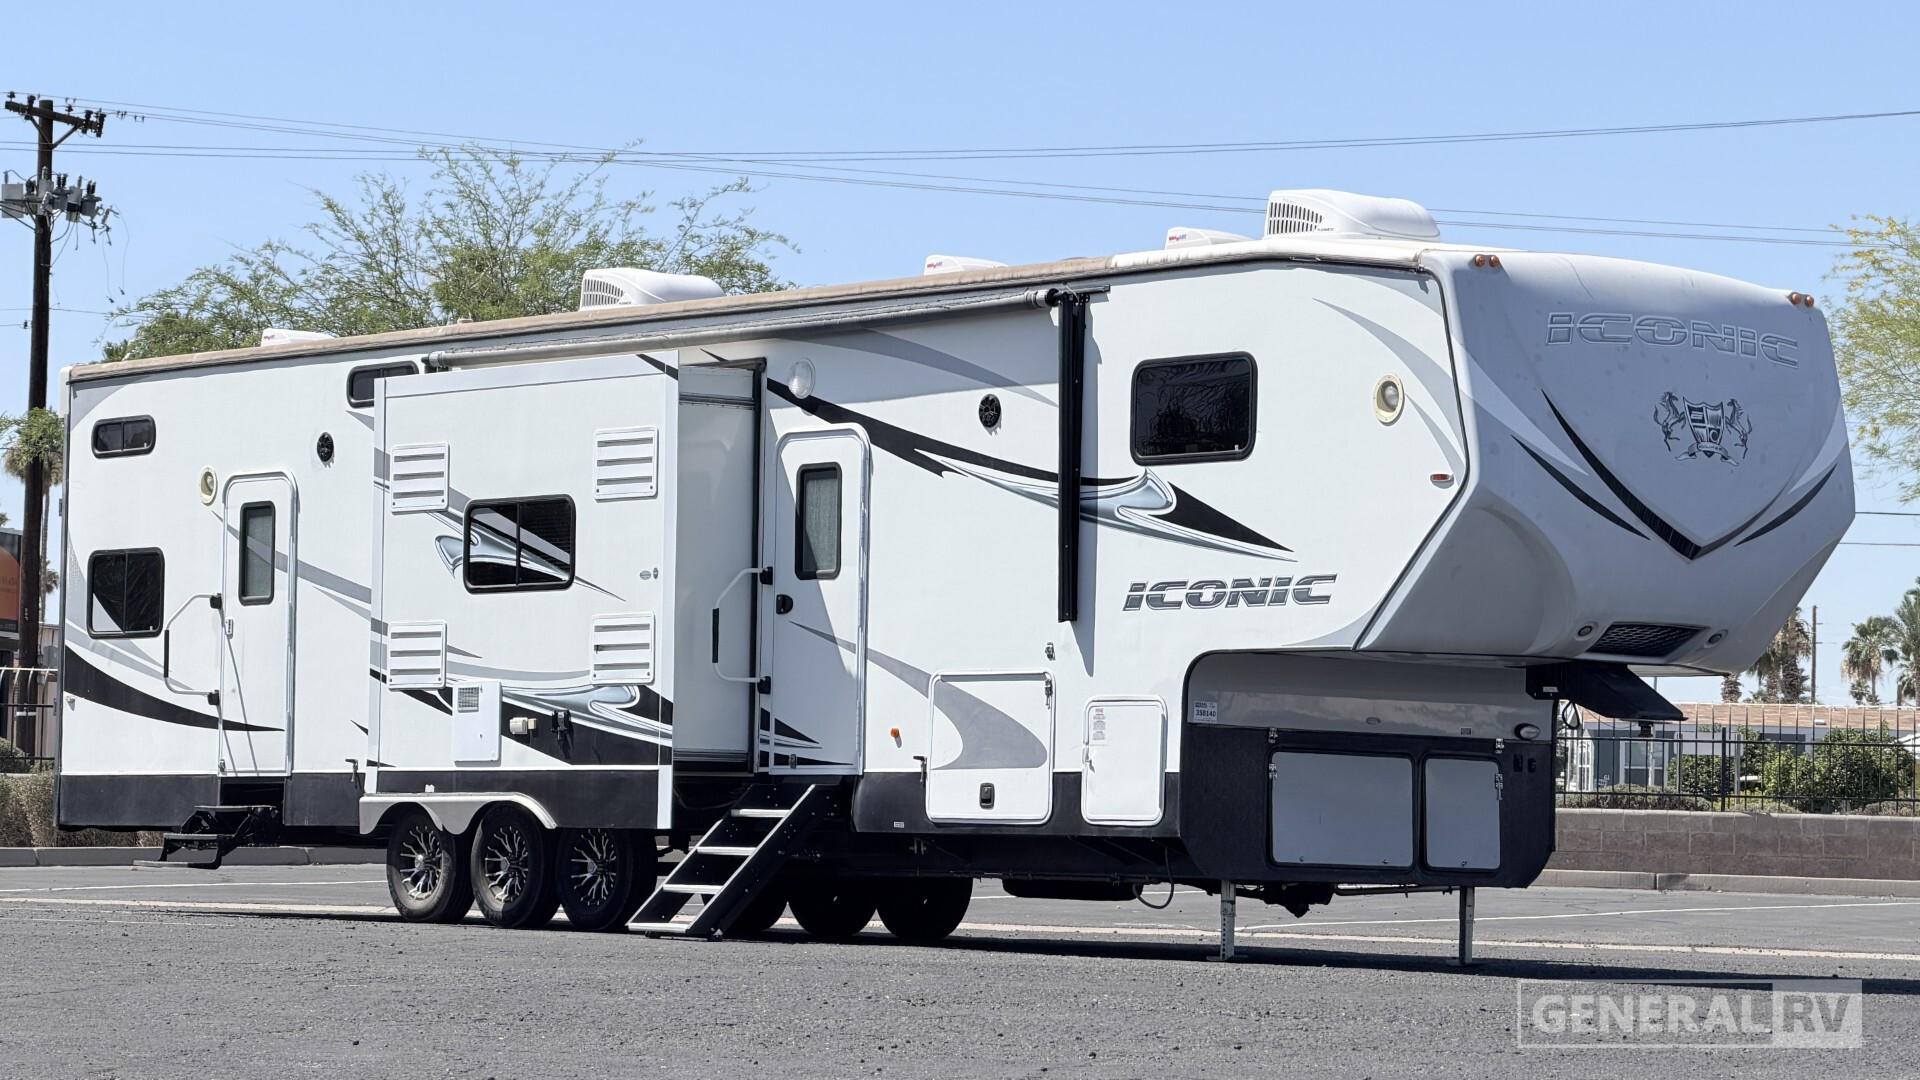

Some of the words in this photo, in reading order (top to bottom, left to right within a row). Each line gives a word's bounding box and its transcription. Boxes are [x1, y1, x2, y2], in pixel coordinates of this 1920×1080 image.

[1545, 312, 1798, 368] ICONIC
[1122, 573, 1338, 612] ICONIC
[1195, 709, 1216, 717] 358140
